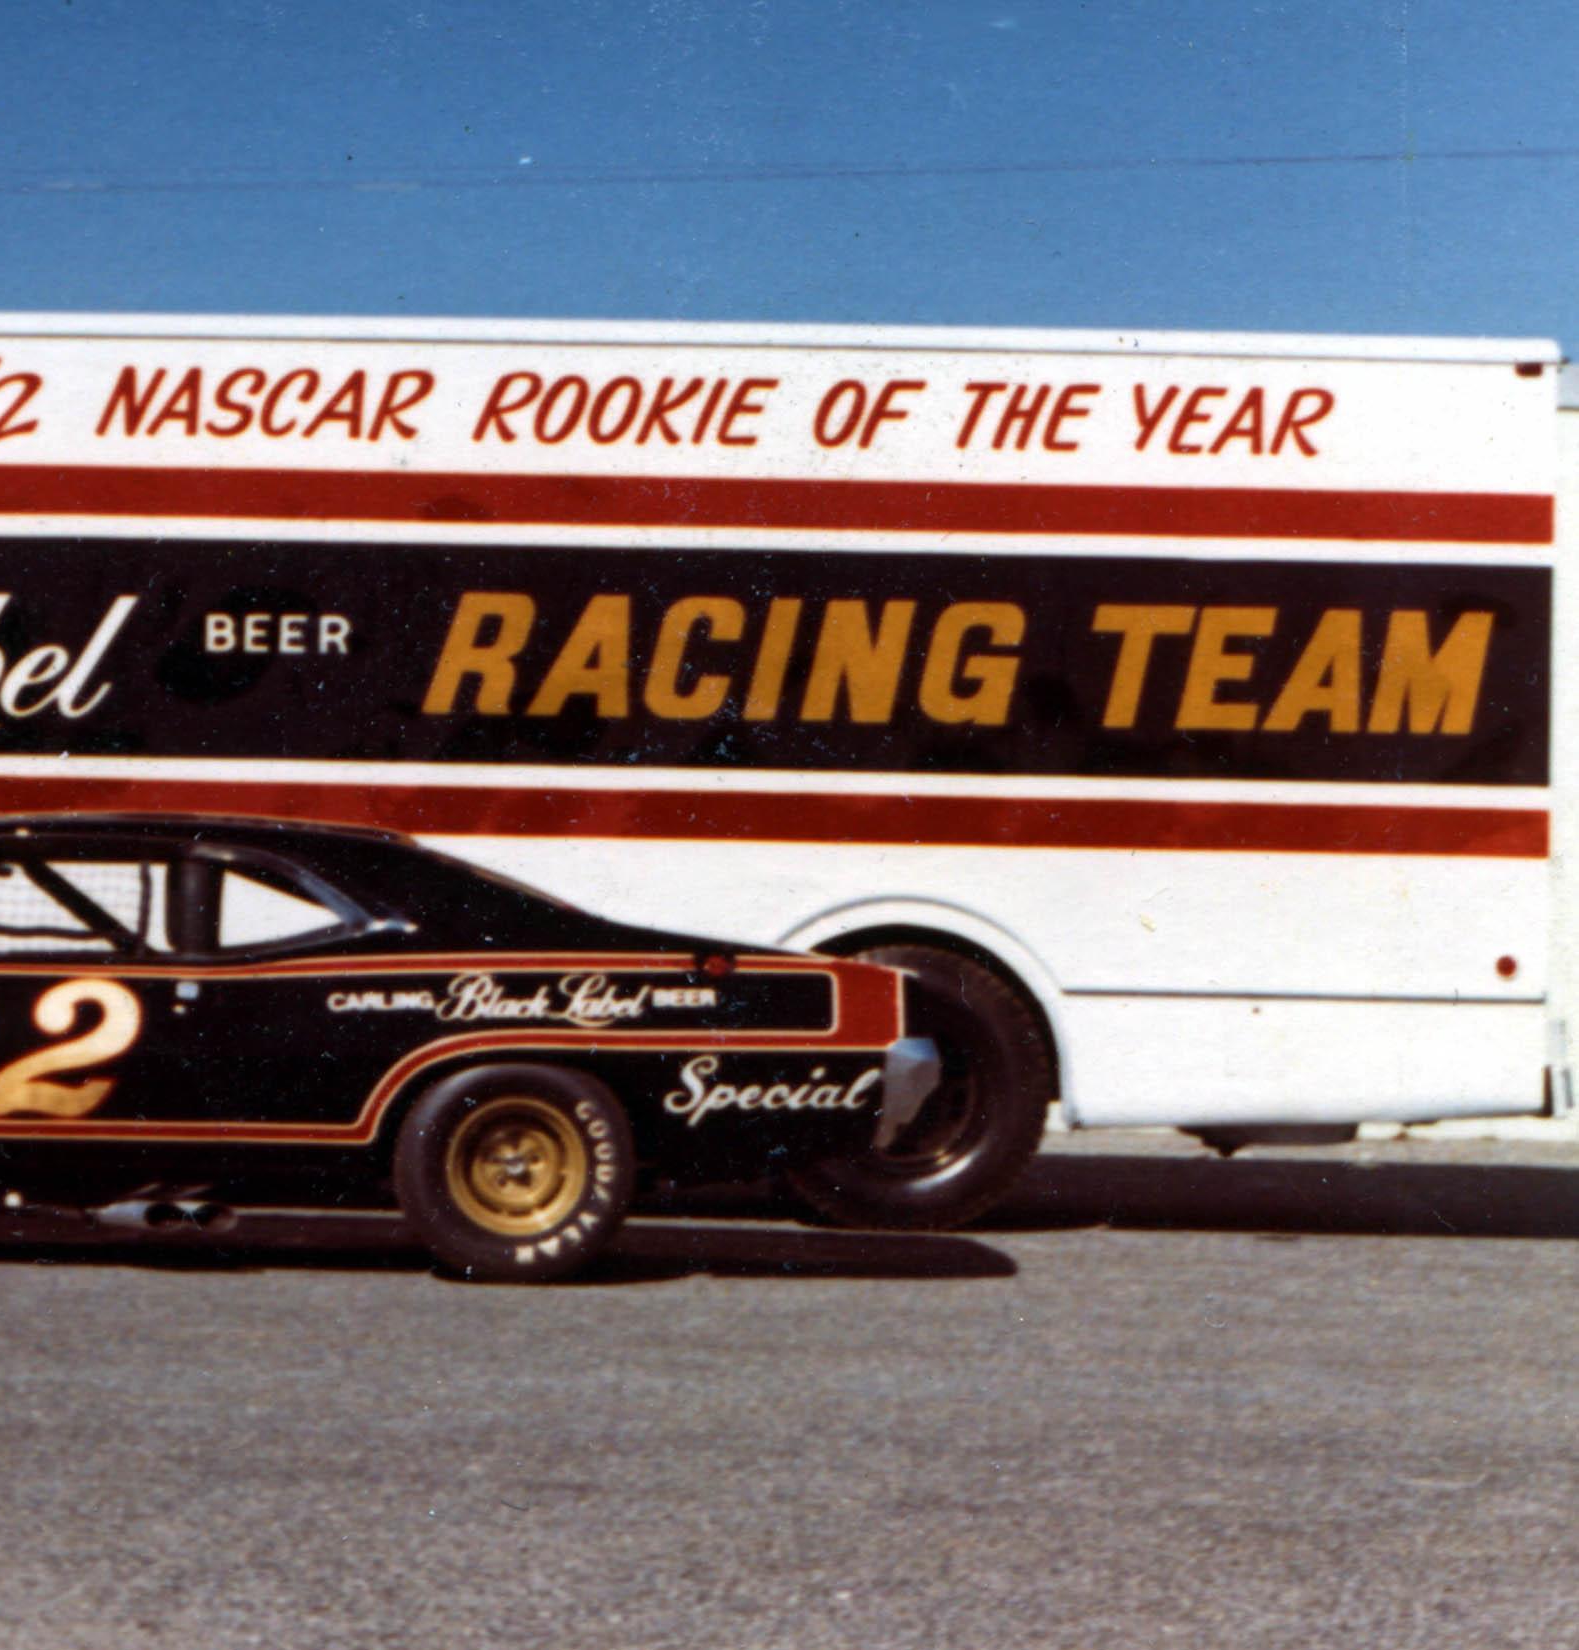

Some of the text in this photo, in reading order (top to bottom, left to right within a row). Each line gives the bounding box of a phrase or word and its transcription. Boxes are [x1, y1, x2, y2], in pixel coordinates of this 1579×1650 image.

[95, 367, 435, 442] NASCAR
[472, 371, 777, 446] ROOKIE
[812, 379, 927, 448] OF
[953, 382, 1100, 452] THE
[1132, 384, 1335, 457] YEAR
[205, 613, 352, 655] BEER
[422, 591, 1026, 727] RACING
[1091, 603, 1494, 736] TEAM
[327, 972, 717, 1027] CARLING Black Label BEER
[663, 1054, 882, 1128] Special
